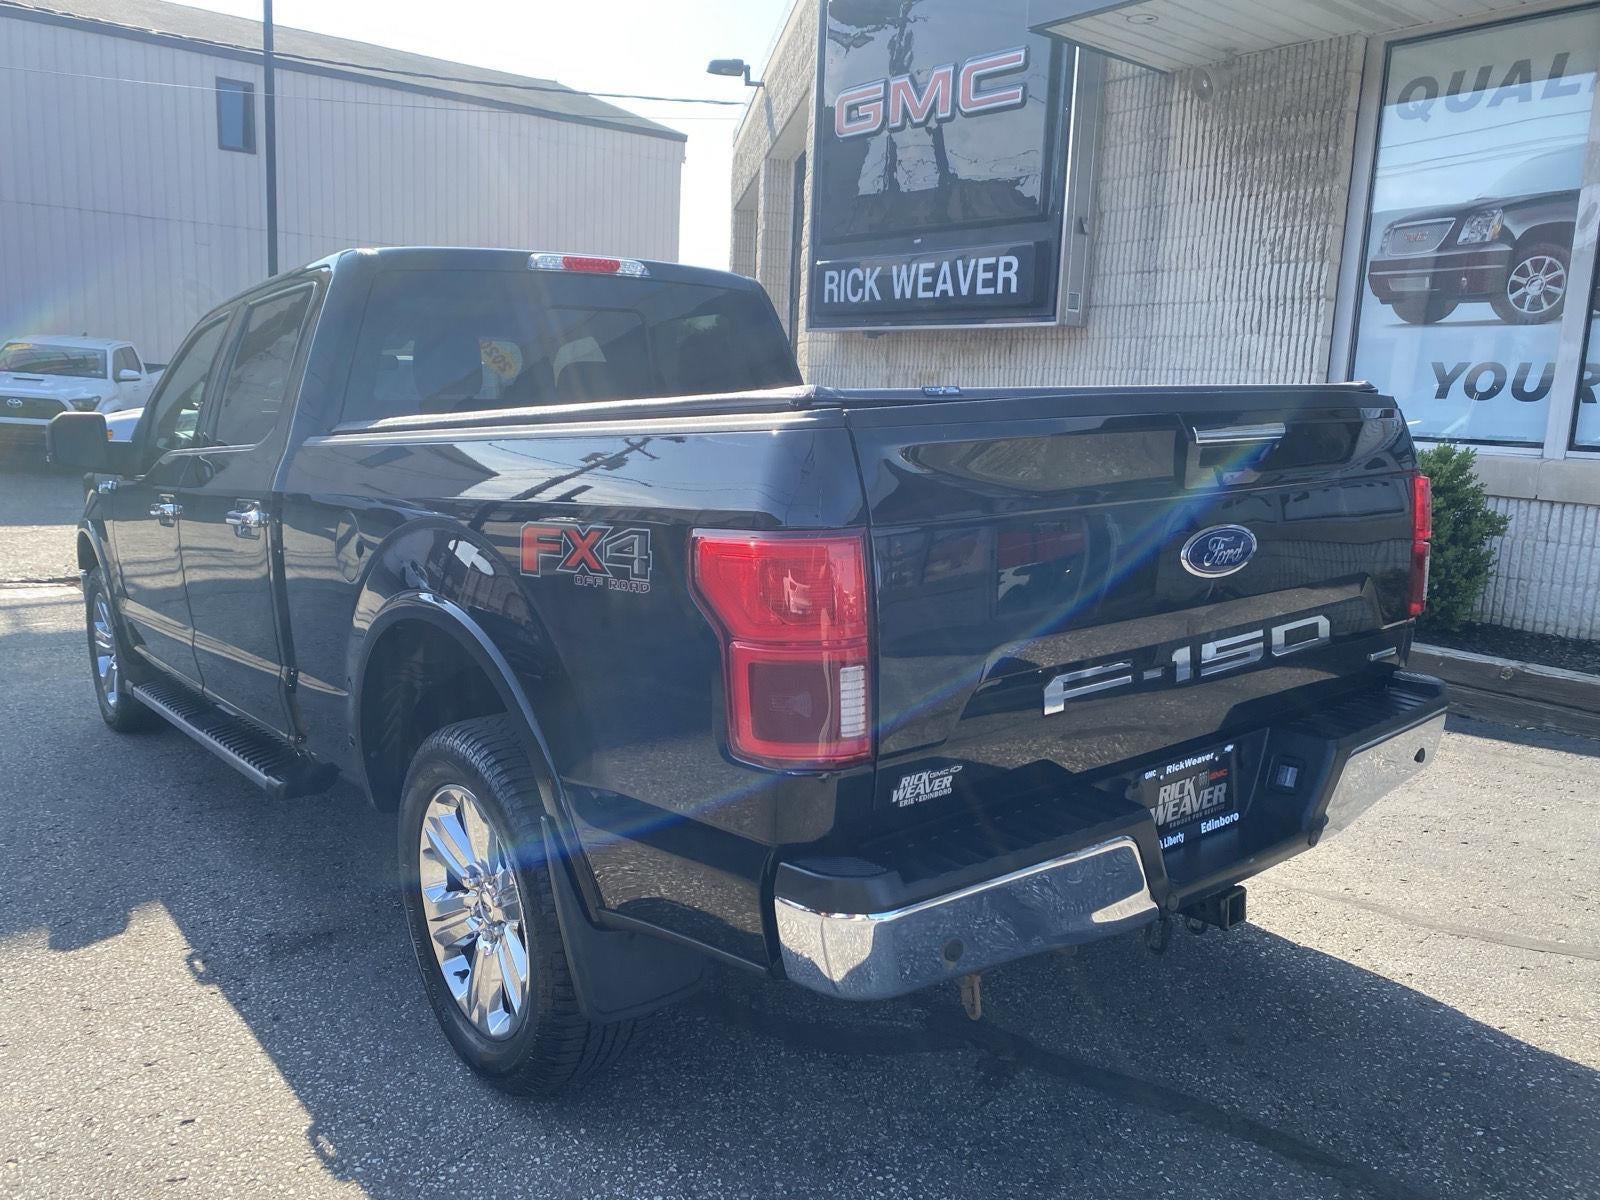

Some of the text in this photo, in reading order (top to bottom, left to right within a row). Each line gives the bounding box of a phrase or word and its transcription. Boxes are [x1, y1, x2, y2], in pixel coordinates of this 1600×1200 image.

[834, 46, 1030, 138] GMC
[1396, 51, 1595, 121] QUAL
[823, 255, 1019, 304] RICK WEAVER
[520, 520, 653, 582] FX4
[1203, 535, 1245, 567] Ford
[573, 574, 650, 594] OFF ROAD
[1044, 614, 1331, 716] F-150
[893, 776, 953, 802] WEAVER
[900, 771, 931, 789] RICK
[1158, 776, 1196, 806] RICK
[899, 788, 952, 807] ERIE EDINBORO
[1150, 782, 1228, 826] WEAVER
[1200, 812, 1240, 834] Edinboro
[1163, 831, 1185, 849] Liberty
